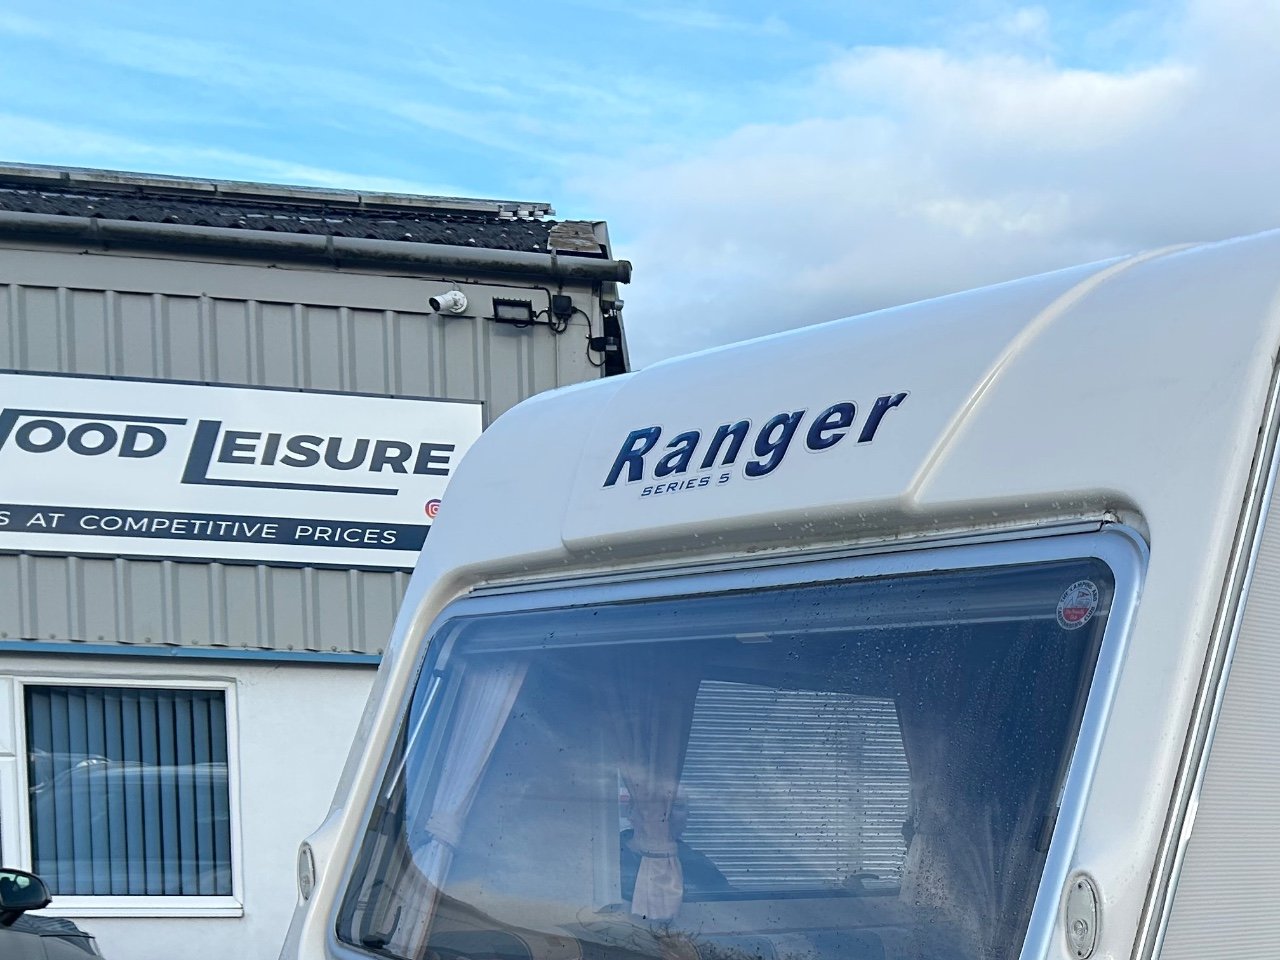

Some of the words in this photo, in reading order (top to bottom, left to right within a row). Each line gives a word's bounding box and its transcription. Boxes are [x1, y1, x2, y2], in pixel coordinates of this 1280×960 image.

[181, 419, 456, 495] LEISURE
[602, 391, 909, 488] Ranger
[640, 475, 711, 497] SERIES
[718, 472, 730, 484] 5
[26, 512, 65, 528] AT
[79, 514, 279, 540] COMPETITIVE
[294, 525, 398, 545] PRICES
